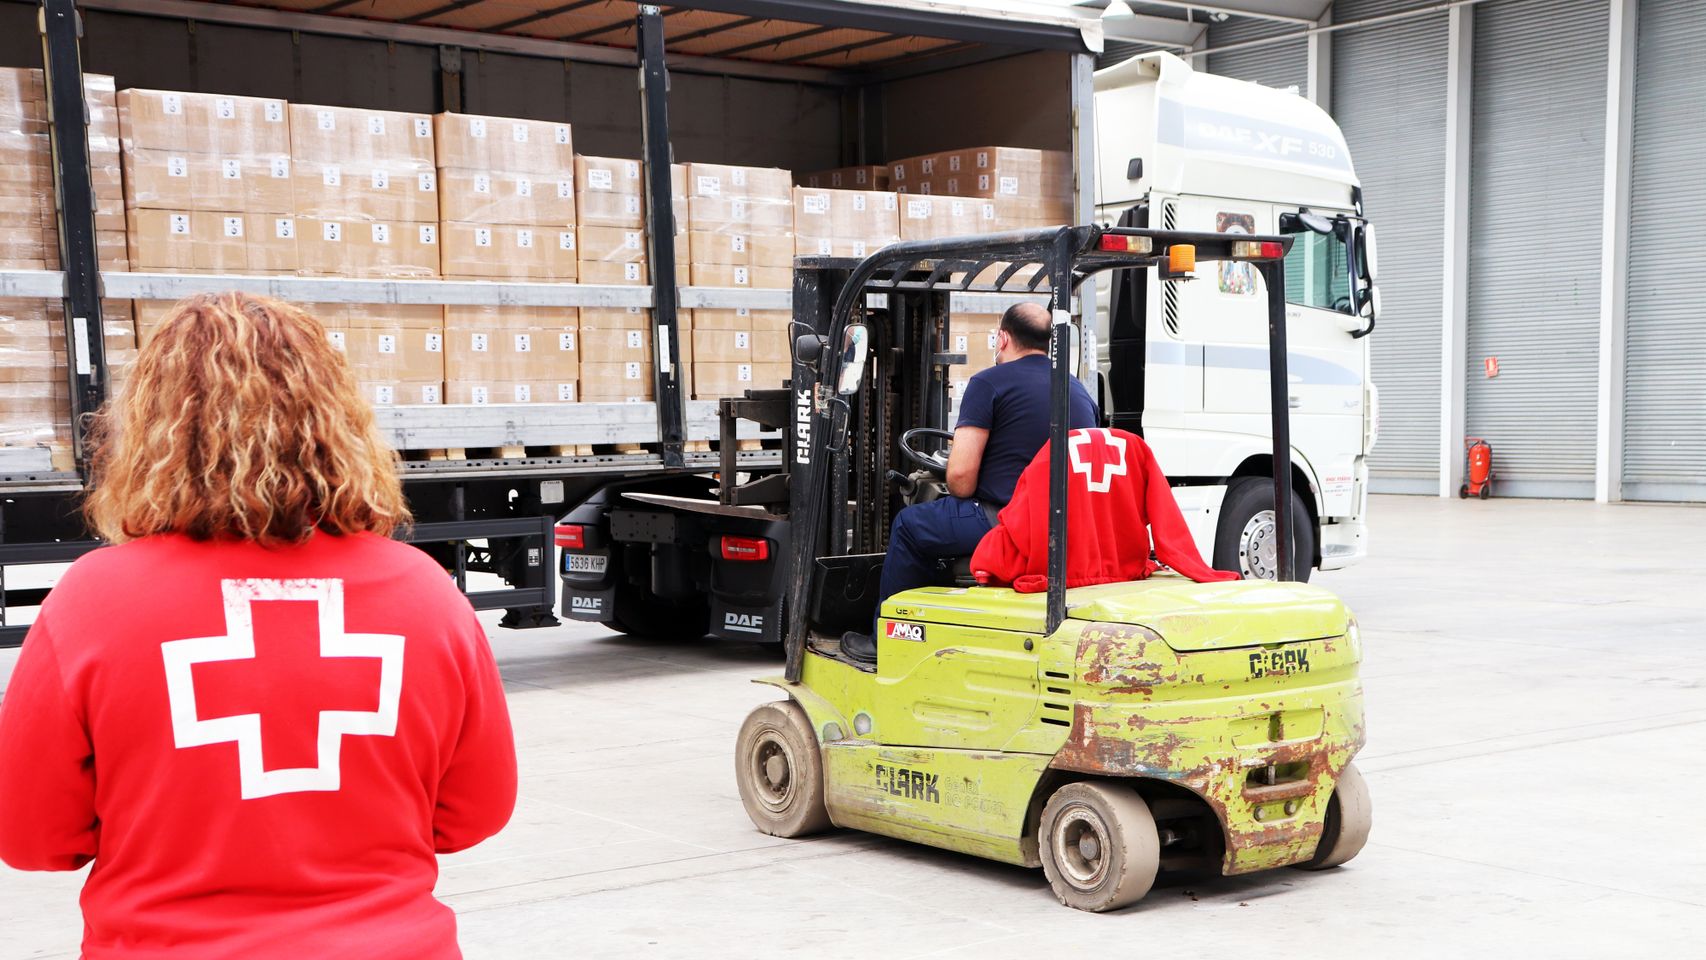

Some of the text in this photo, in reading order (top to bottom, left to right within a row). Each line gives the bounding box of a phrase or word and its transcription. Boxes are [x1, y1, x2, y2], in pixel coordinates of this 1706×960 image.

[1253, 130, 1304, 155] XF
[1308, 141, 1336, 159] 530
[796, 389, 812, 465] CLARK
[570, 556, 605, 570] 5636 KHP
[571, 596, 602, 608] DAF
[725, 612, 763, 627] DAF
[875, 764, 940, 804] CLARK
